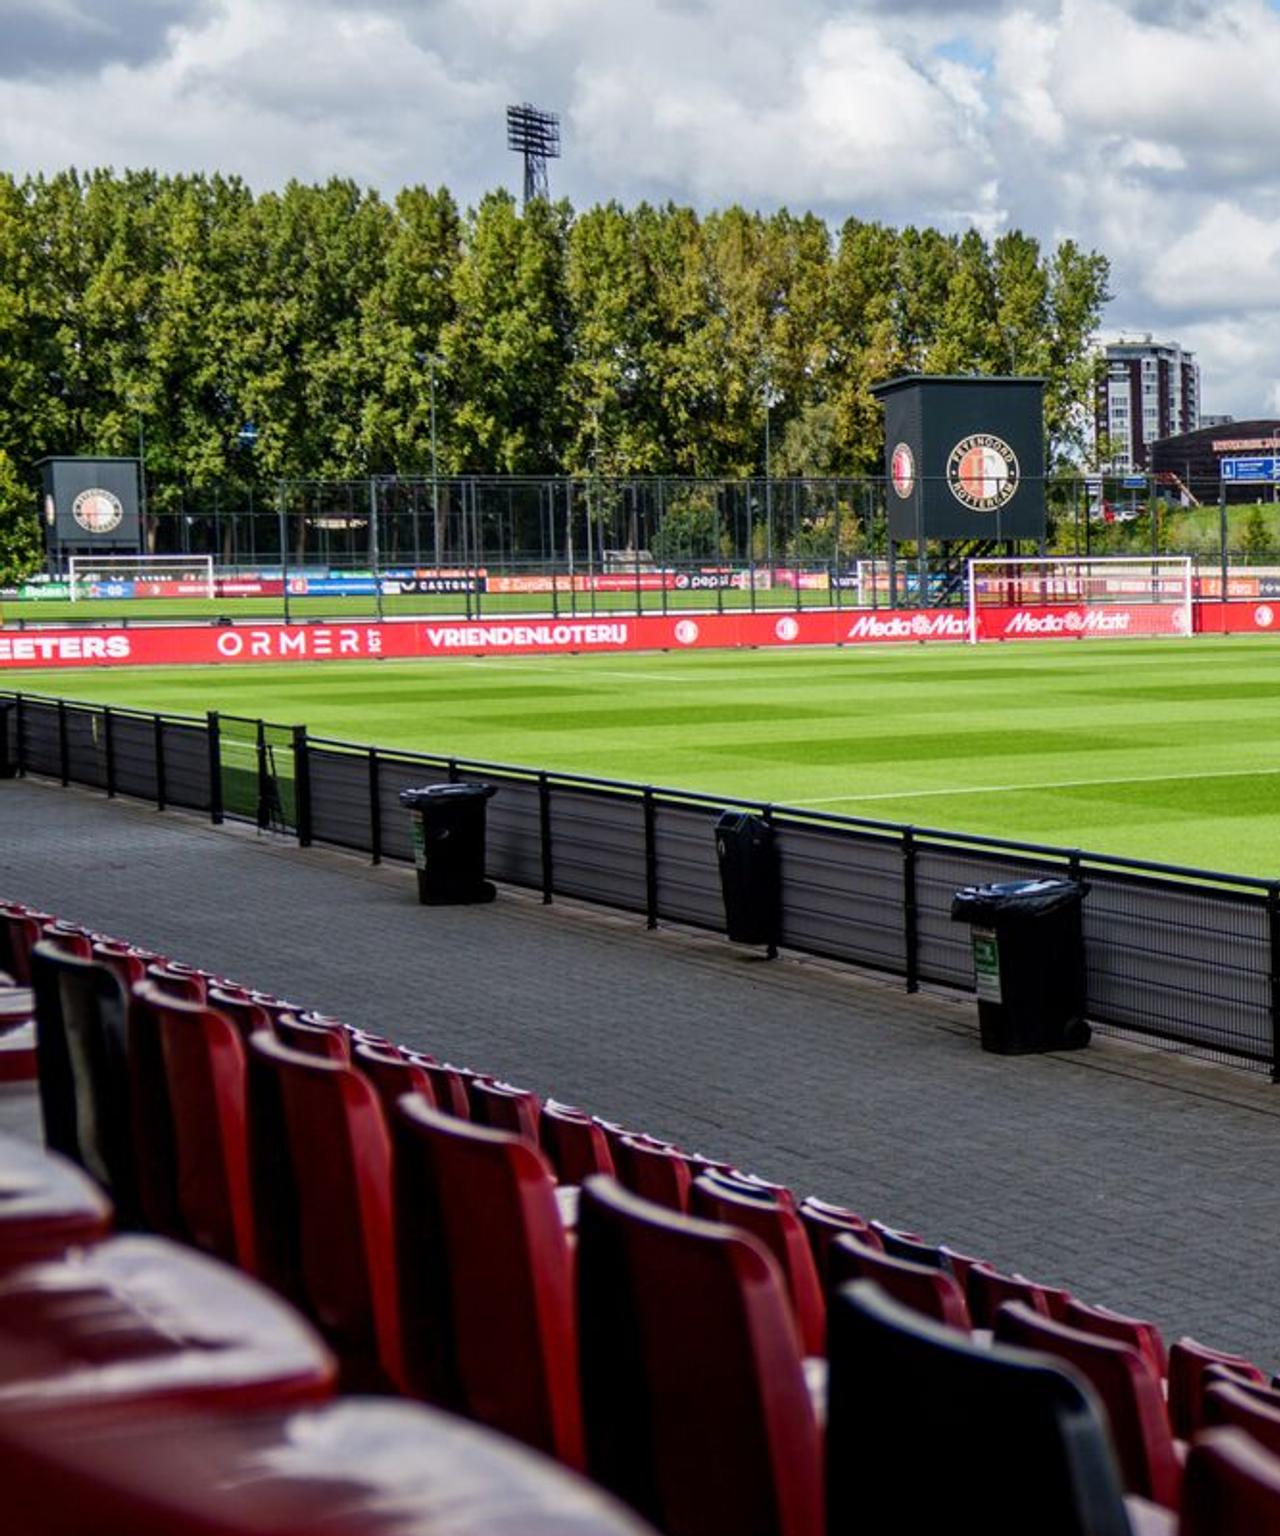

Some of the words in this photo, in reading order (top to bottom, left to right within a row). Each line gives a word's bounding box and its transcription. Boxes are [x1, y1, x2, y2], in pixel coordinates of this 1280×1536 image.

[953, 436, 1014, 463] FEYENOORD
[849, 617, 913, 638] Media
[1005, 612, 1065, 633] Media
[218, 630, 359, 655] ORMER
[428, 623, 627, 647] VRIENDENLOTERIJ
